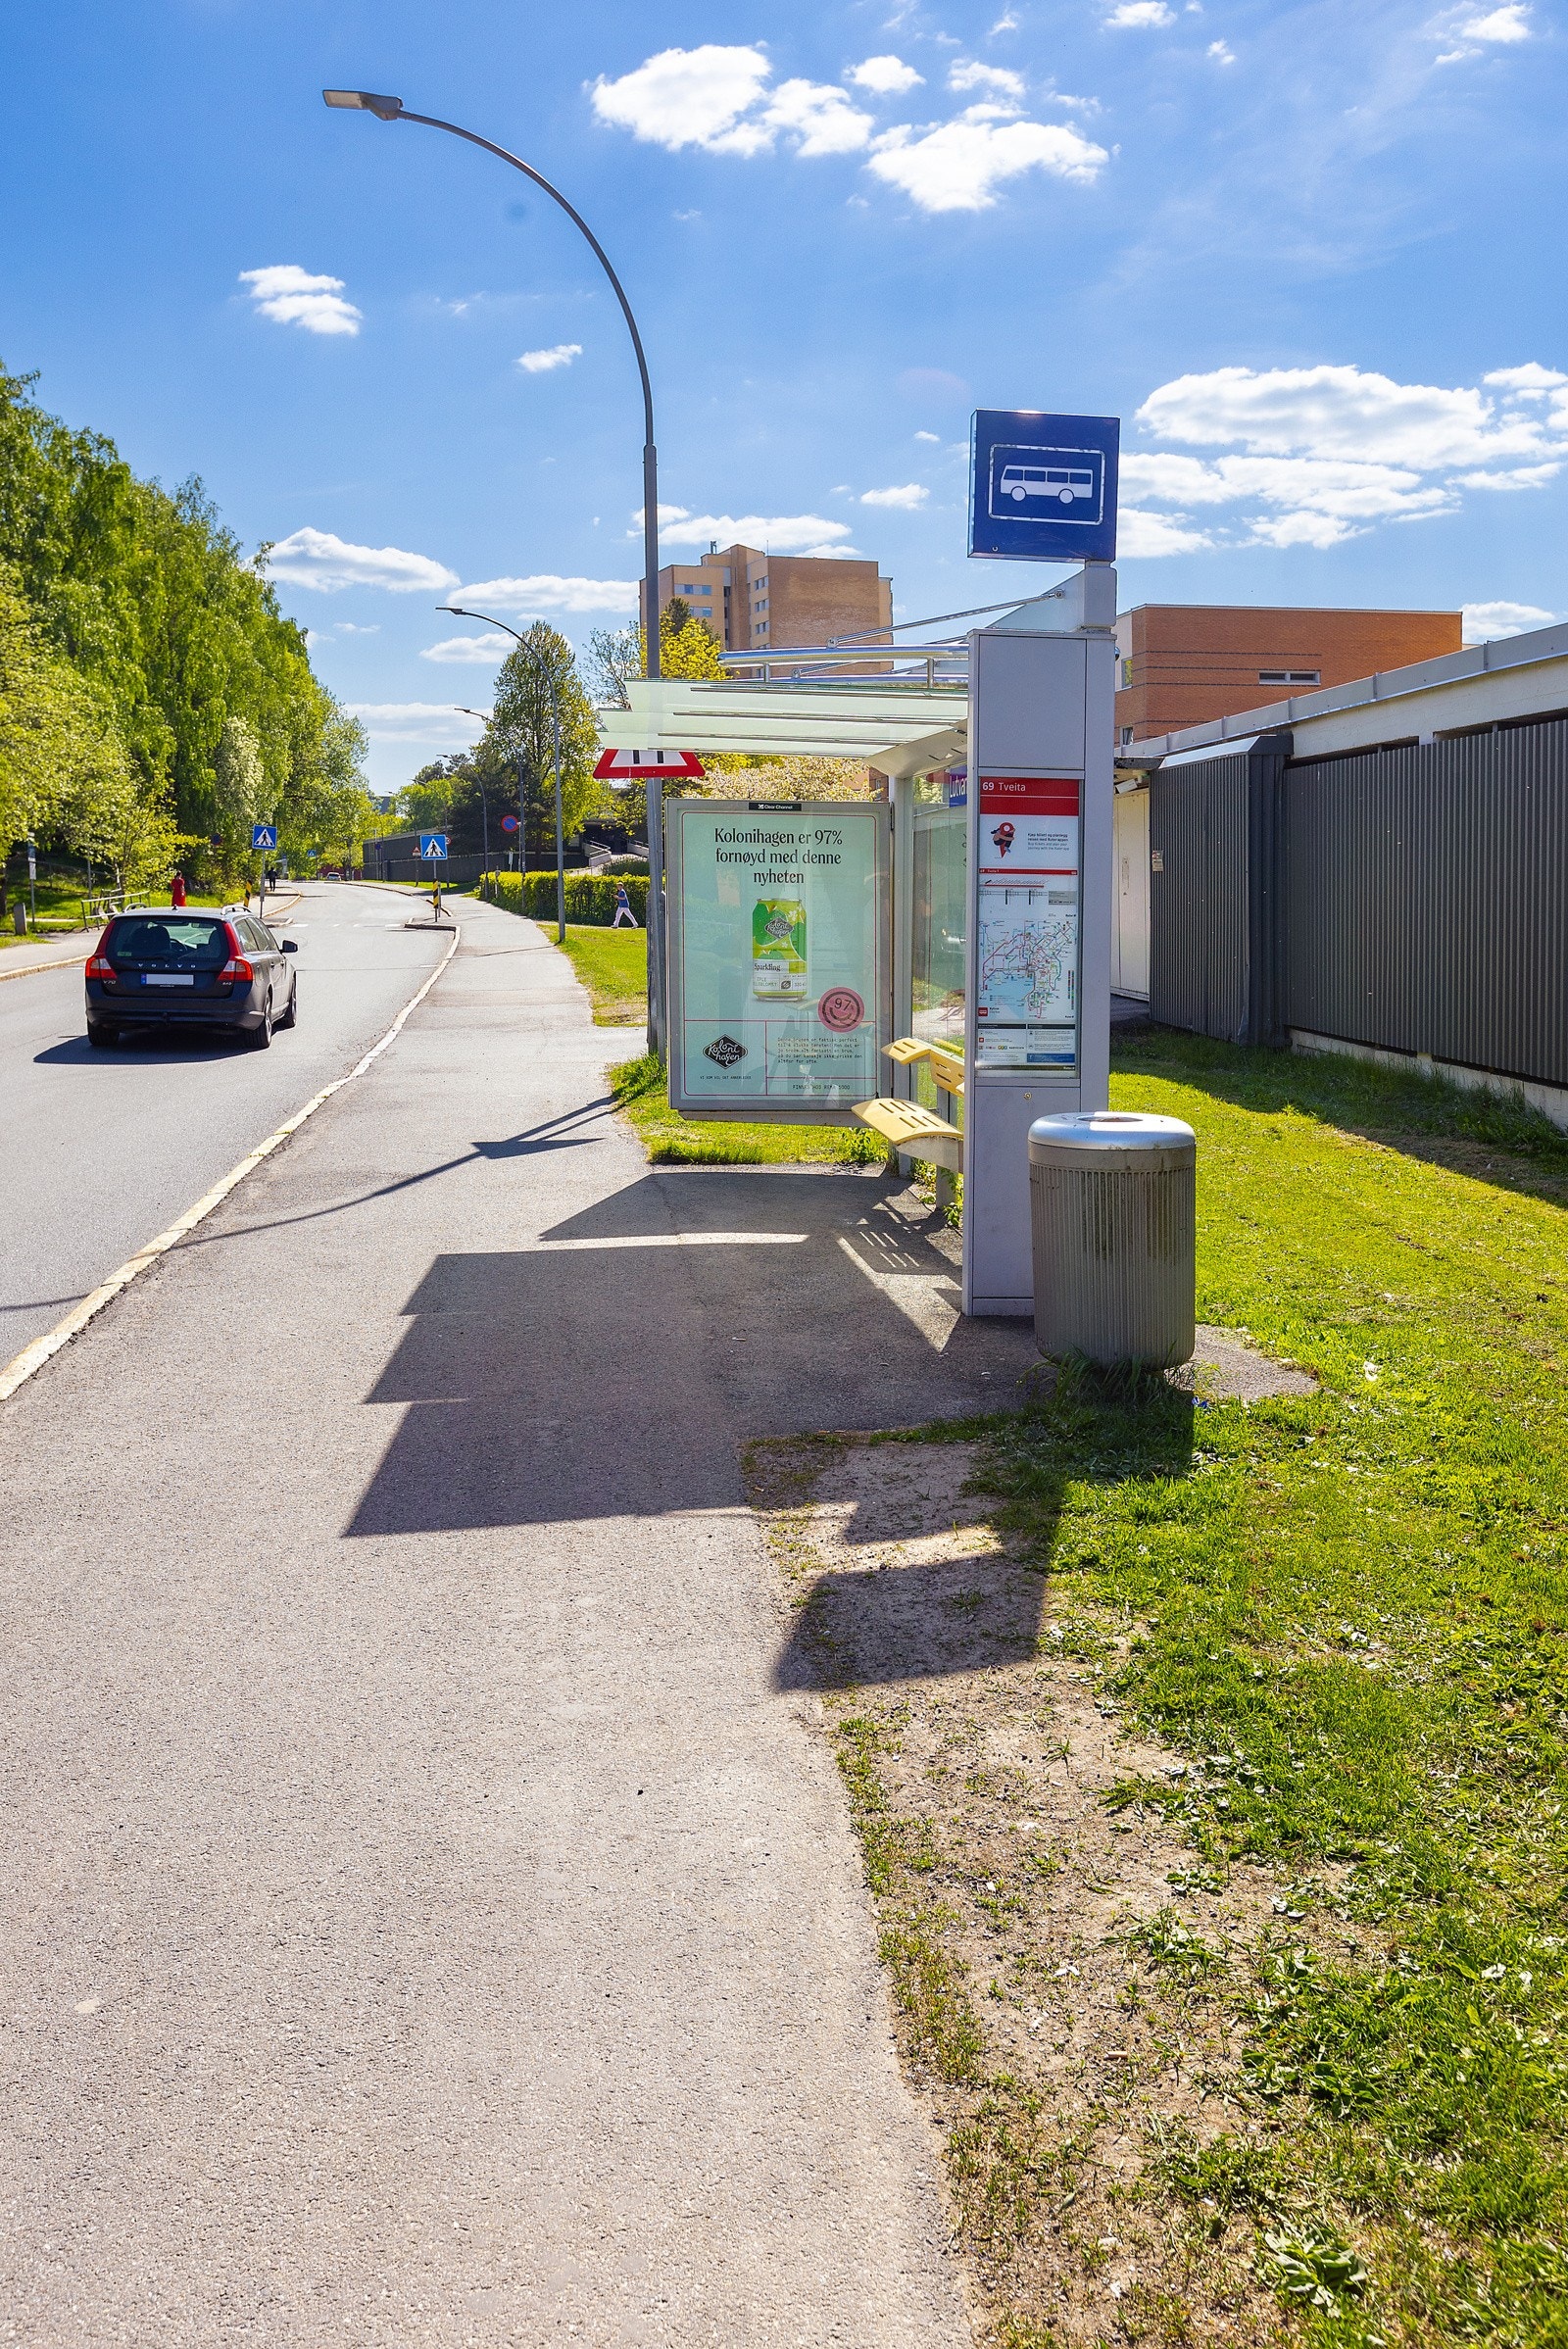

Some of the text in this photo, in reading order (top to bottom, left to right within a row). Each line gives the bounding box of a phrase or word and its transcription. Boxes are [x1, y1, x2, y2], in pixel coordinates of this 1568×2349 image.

[982, 782, 1026, 791] 69 Tveita
[715, 828, 842, 847] Kolonihagen er 97%
[716, 848, 841, 866] fornøyd med denne
[754, 869, 804, 886] nyheten
[754, 963, 781, 971] Sparkling
